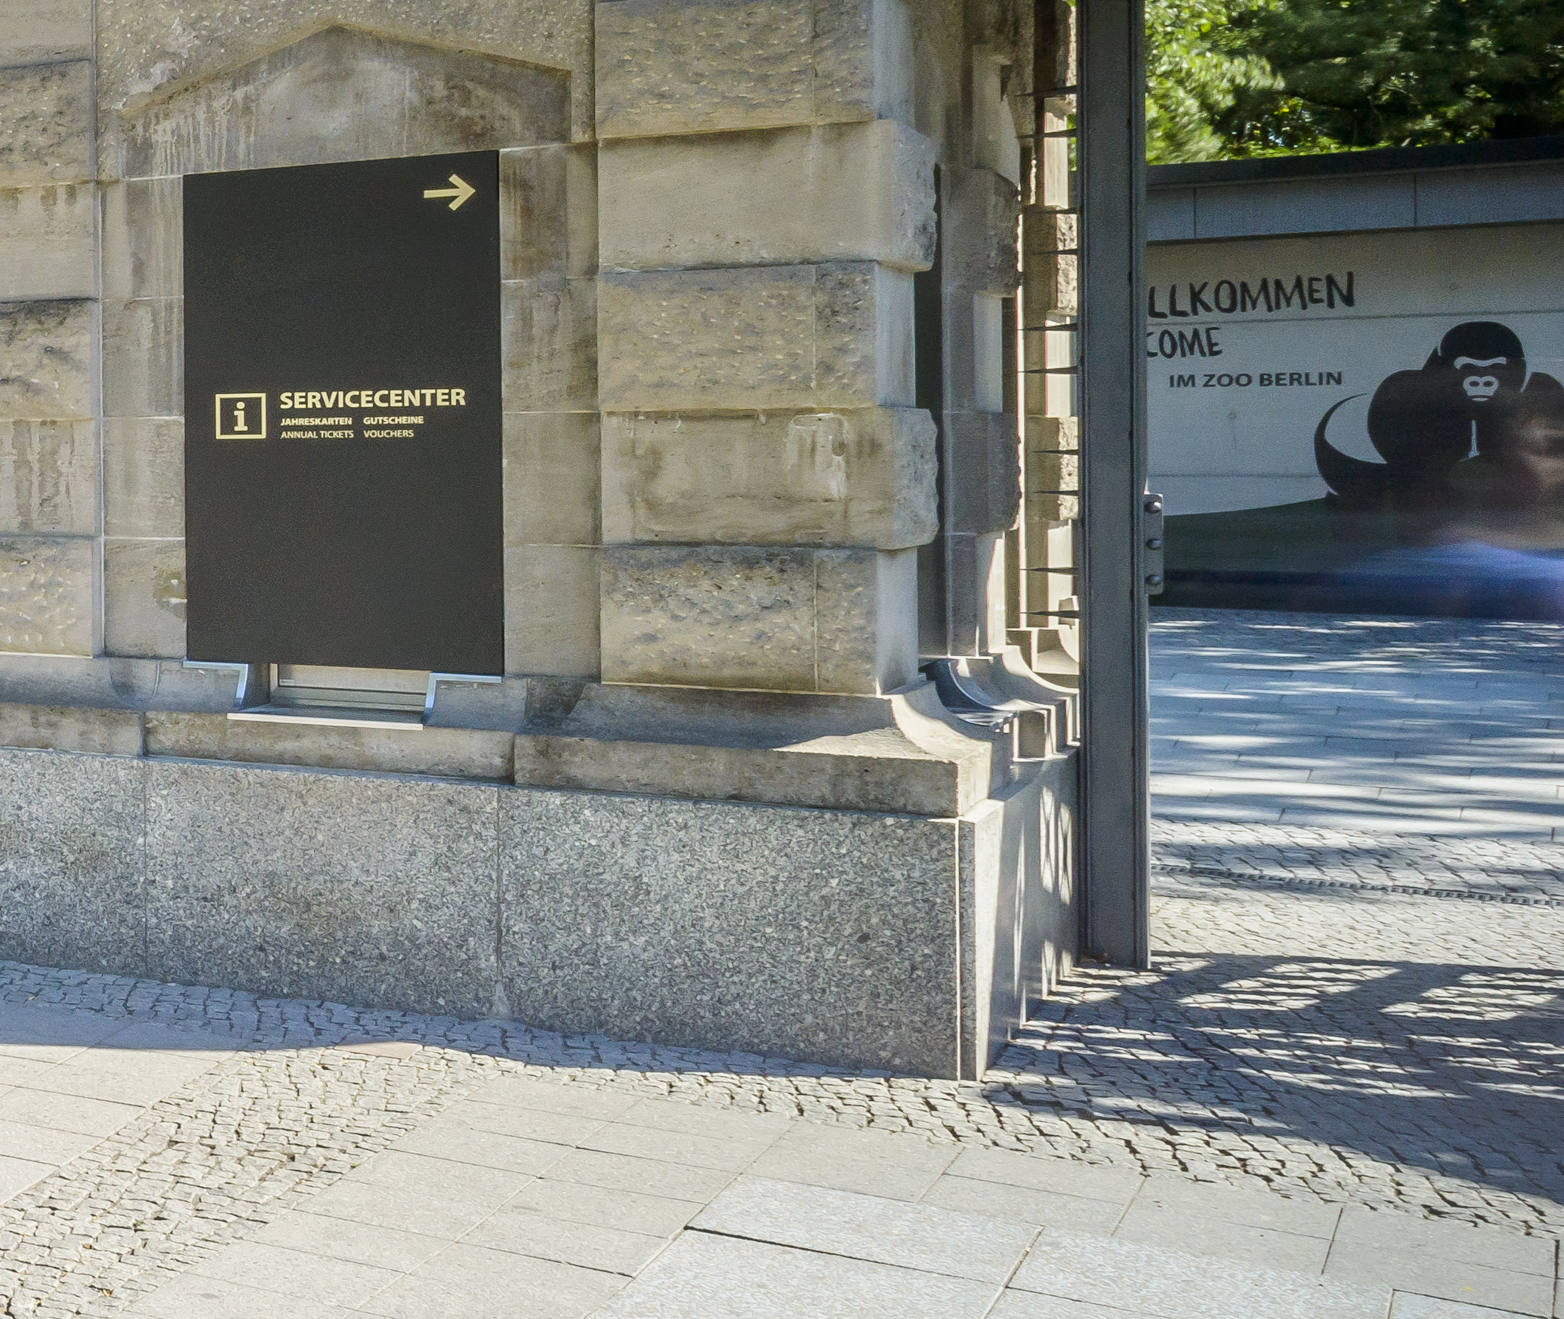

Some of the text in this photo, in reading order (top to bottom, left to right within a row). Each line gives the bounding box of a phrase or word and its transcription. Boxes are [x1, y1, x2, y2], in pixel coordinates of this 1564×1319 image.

[1148, 271, 1355, 319] LLKOMMEN
[1146, 327, 1223, 359] COME
[1169, 371, 1343, 389] IM ZOO BERLIN
[279, 388, 467, 410] SERVICECENTER
[280, 417, 353, 427] JAHRESKARTEN
[363, 415, 425, 425] GUTSCHEINE
[280, 430, 355, 440] ANNUAL TICKETS
[363, 429, 415, 438] VOUCHERS
